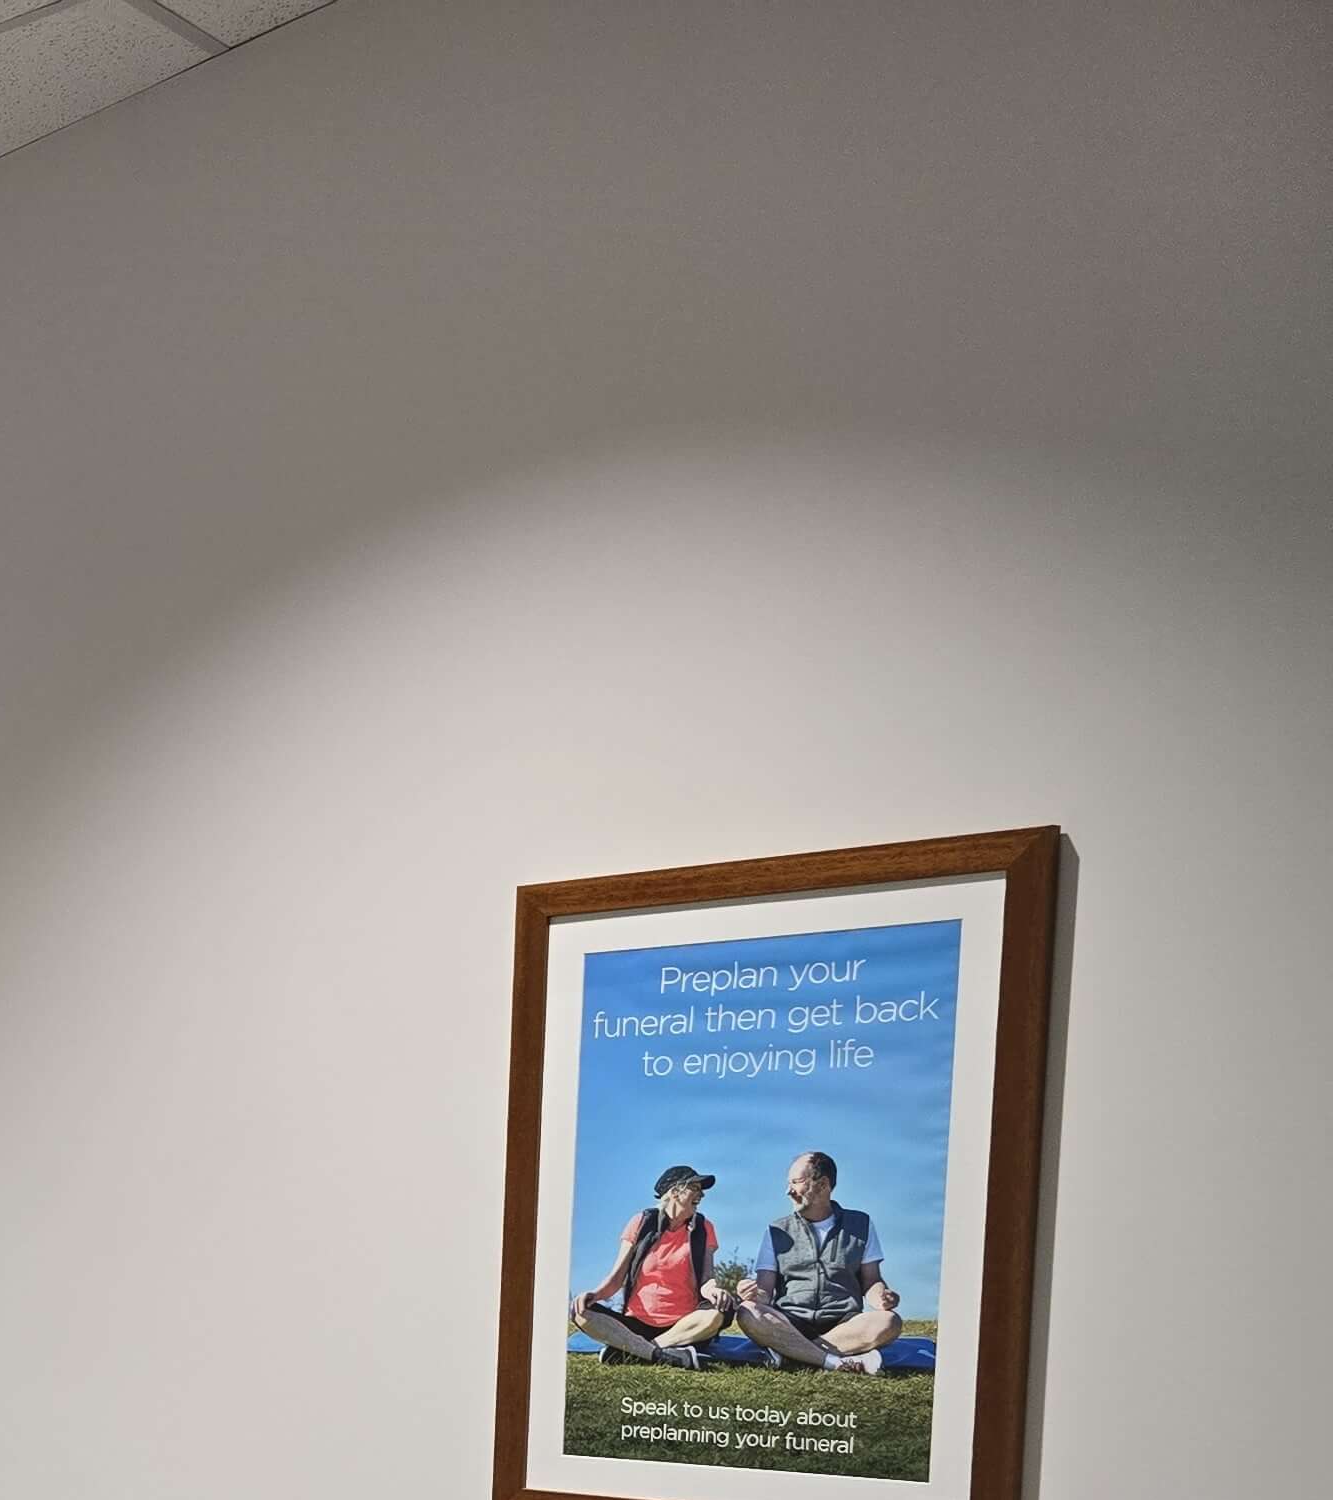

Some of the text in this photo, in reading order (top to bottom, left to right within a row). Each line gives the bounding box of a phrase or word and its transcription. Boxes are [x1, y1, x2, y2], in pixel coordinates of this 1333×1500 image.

[660, 959, 867, 996] Preplan your
[592, 991, 940, 1039] funeral then get back
[642, 1039, 875, 1079] to enjoying life
[620, 1396, 858, 1430] Speak to us today about
[621, 1421, 856, 1455] preplanning your funeral
